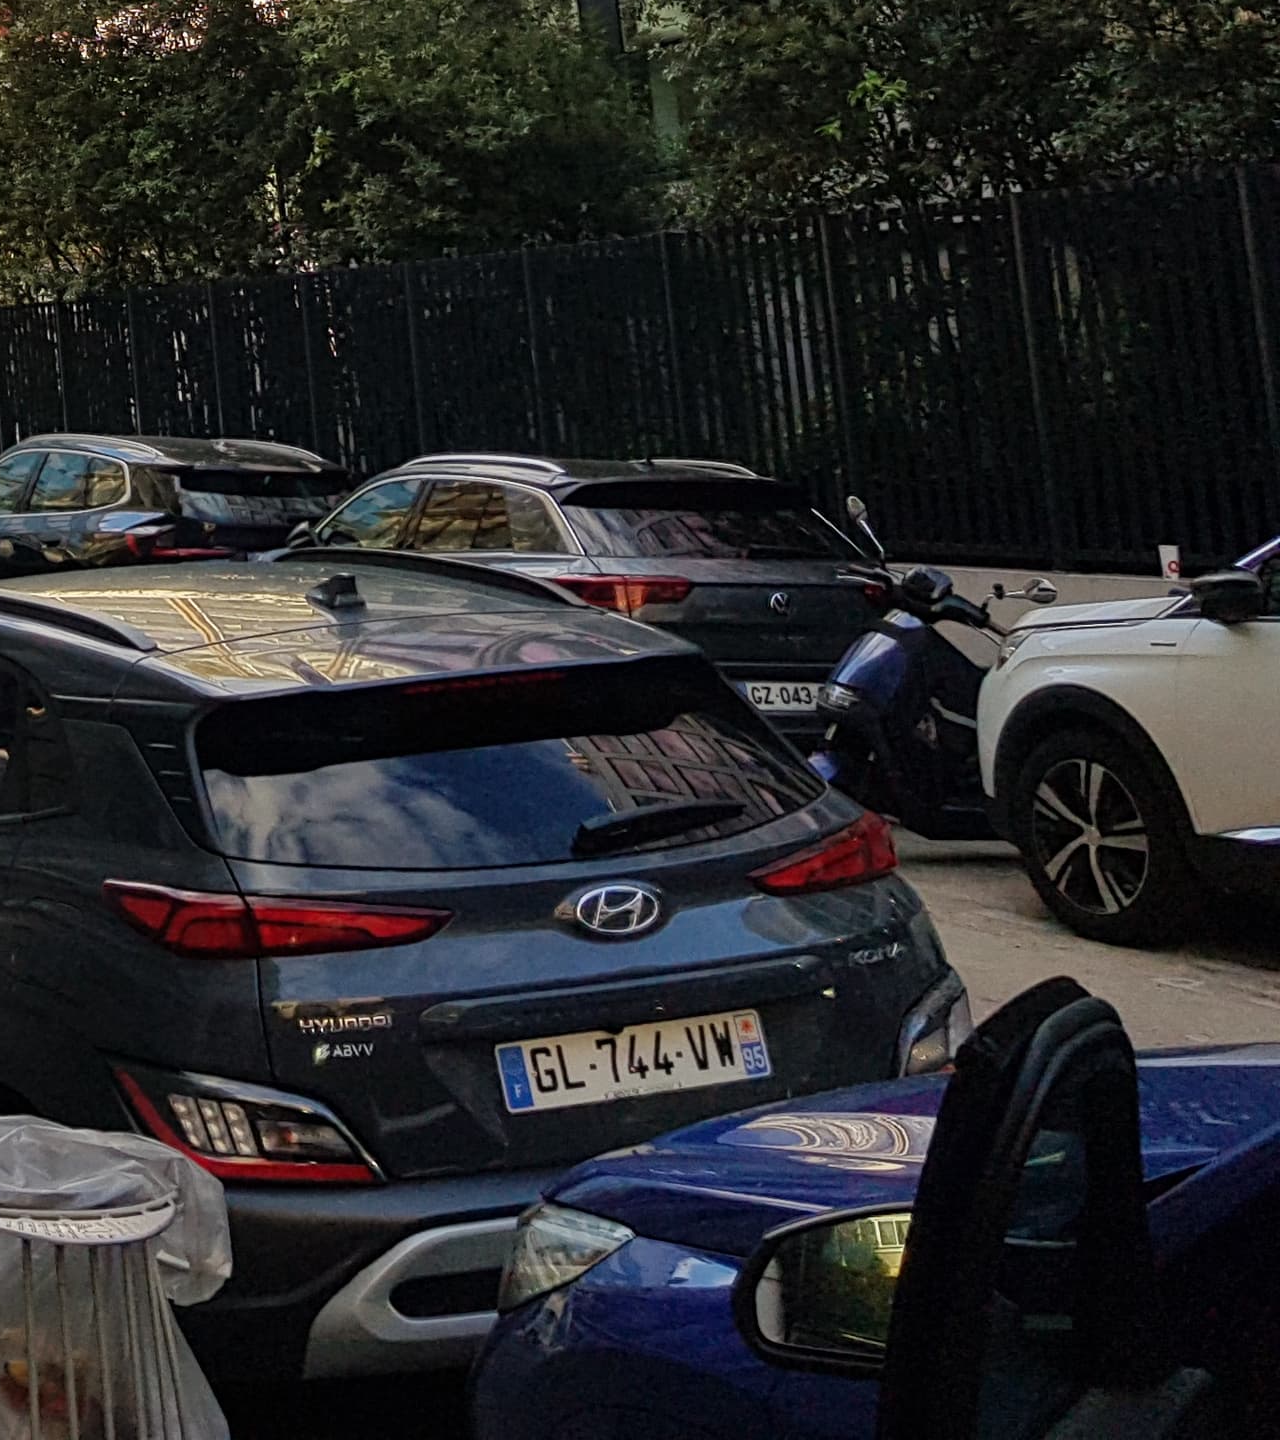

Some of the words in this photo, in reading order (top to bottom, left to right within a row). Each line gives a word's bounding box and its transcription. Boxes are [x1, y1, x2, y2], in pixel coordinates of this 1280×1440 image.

[751, 686, 818, 705] GZ-043-
[299, 1015, 391, 1033] HYUNDAI
[530, 1020, 735, 1093] GL-744-VW
[743, 1045, 765, 1069] 95
